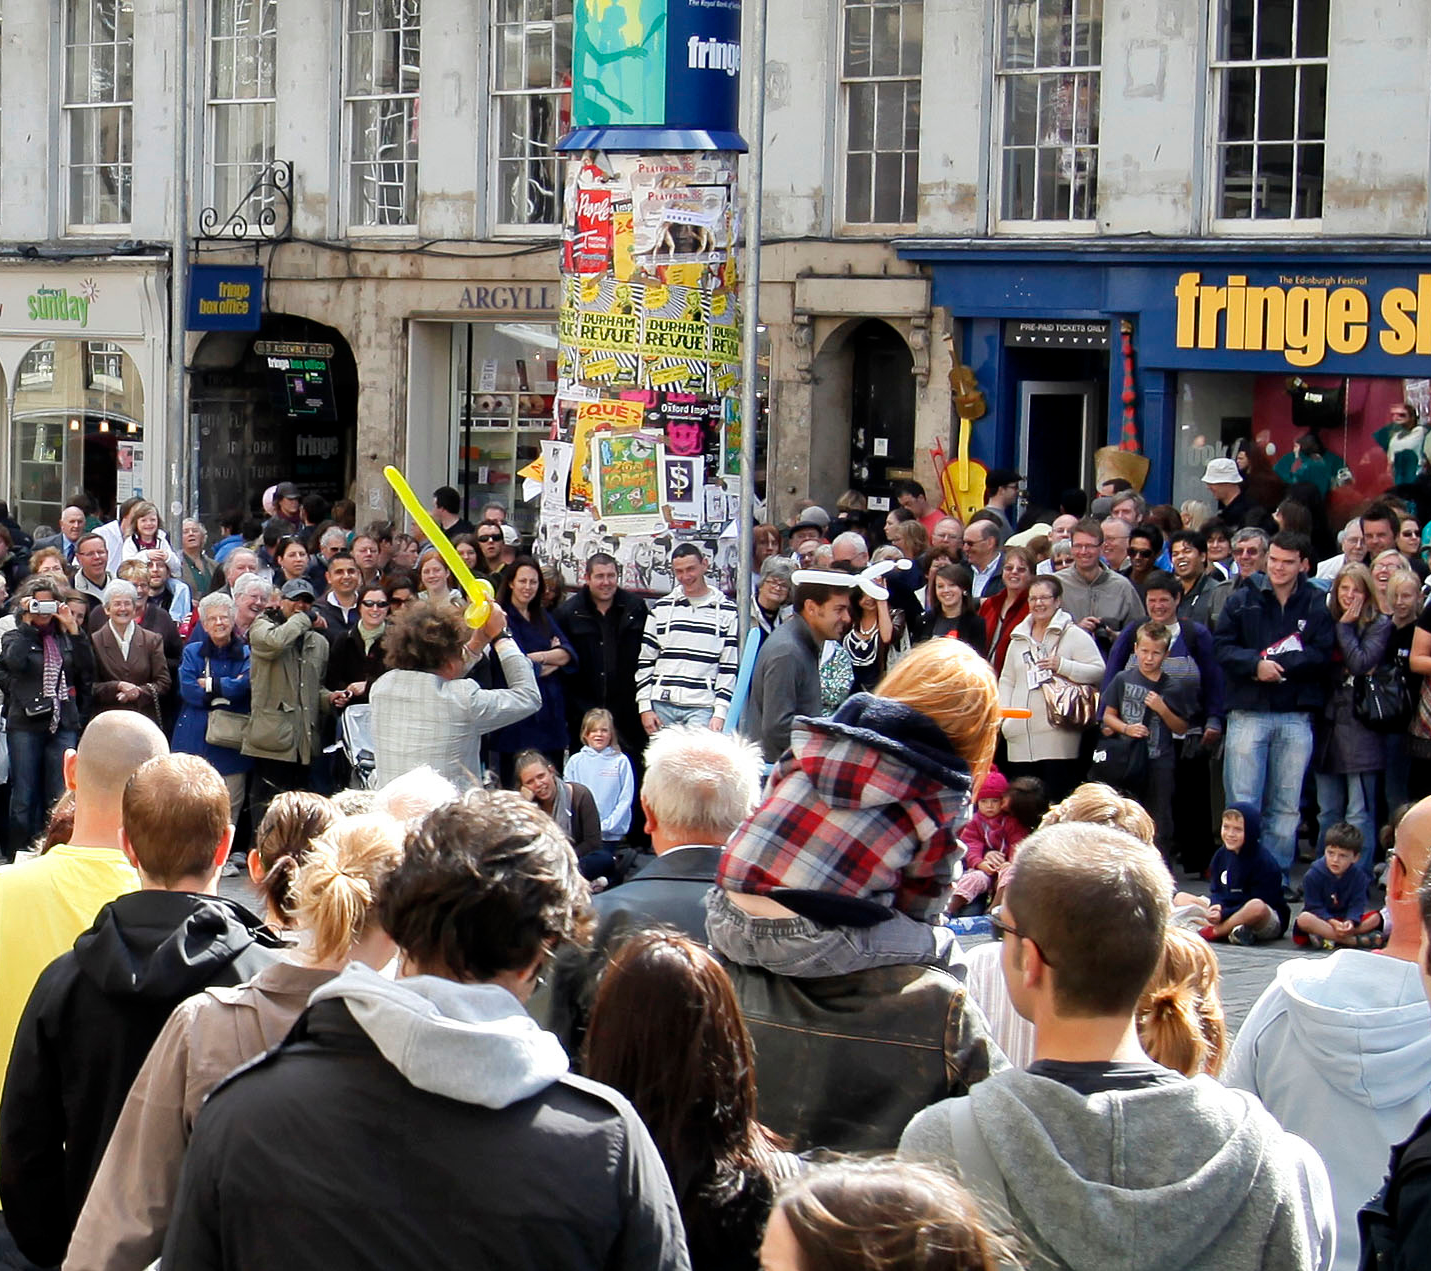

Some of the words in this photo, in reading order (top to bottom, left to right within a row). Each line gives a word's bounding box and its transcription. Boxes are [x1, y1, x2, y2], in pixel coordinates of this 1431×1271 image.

[638, 164, 680, 174] PLATFORM
[647, 192, 689, 202] PLATFORM
[617, 203, 633, 213] Imp
[1278, 276, 1294, 284] The
[1294, 276, 1336, 287] Edinburgh
[1338, 276, 1368, 286] Festival
[219, 282, 250, 300] fringe
[459, 286, 556, 310] ARGYLL
[27, 288, 90, 328] sunday
[199, 298, 218, 314] box
[219, 299, 249, 314] office
[583, 314, 636, 328] DURHAM
[649, 319, 705, 334] DURHAM
[1175, 272, 1369, 367] fringe
[581, 327, 634, 344] REVUE
[1020, 323, 1054, 332] PRE-PAID
[1055, 323, 1086, 333] TICKETS
[1087, 324, 1107, 333] ONLY
[645, 332, 703, 350] REVUE
[267, 357, 290, 371] fringe
[290, 358, 304, 370] box
[304, 359, 327, 371] office
[661, 403, 689, 414] Oxford
[690, 405, 708, 416] Imps
[296, 434, 339, 460] fringe
